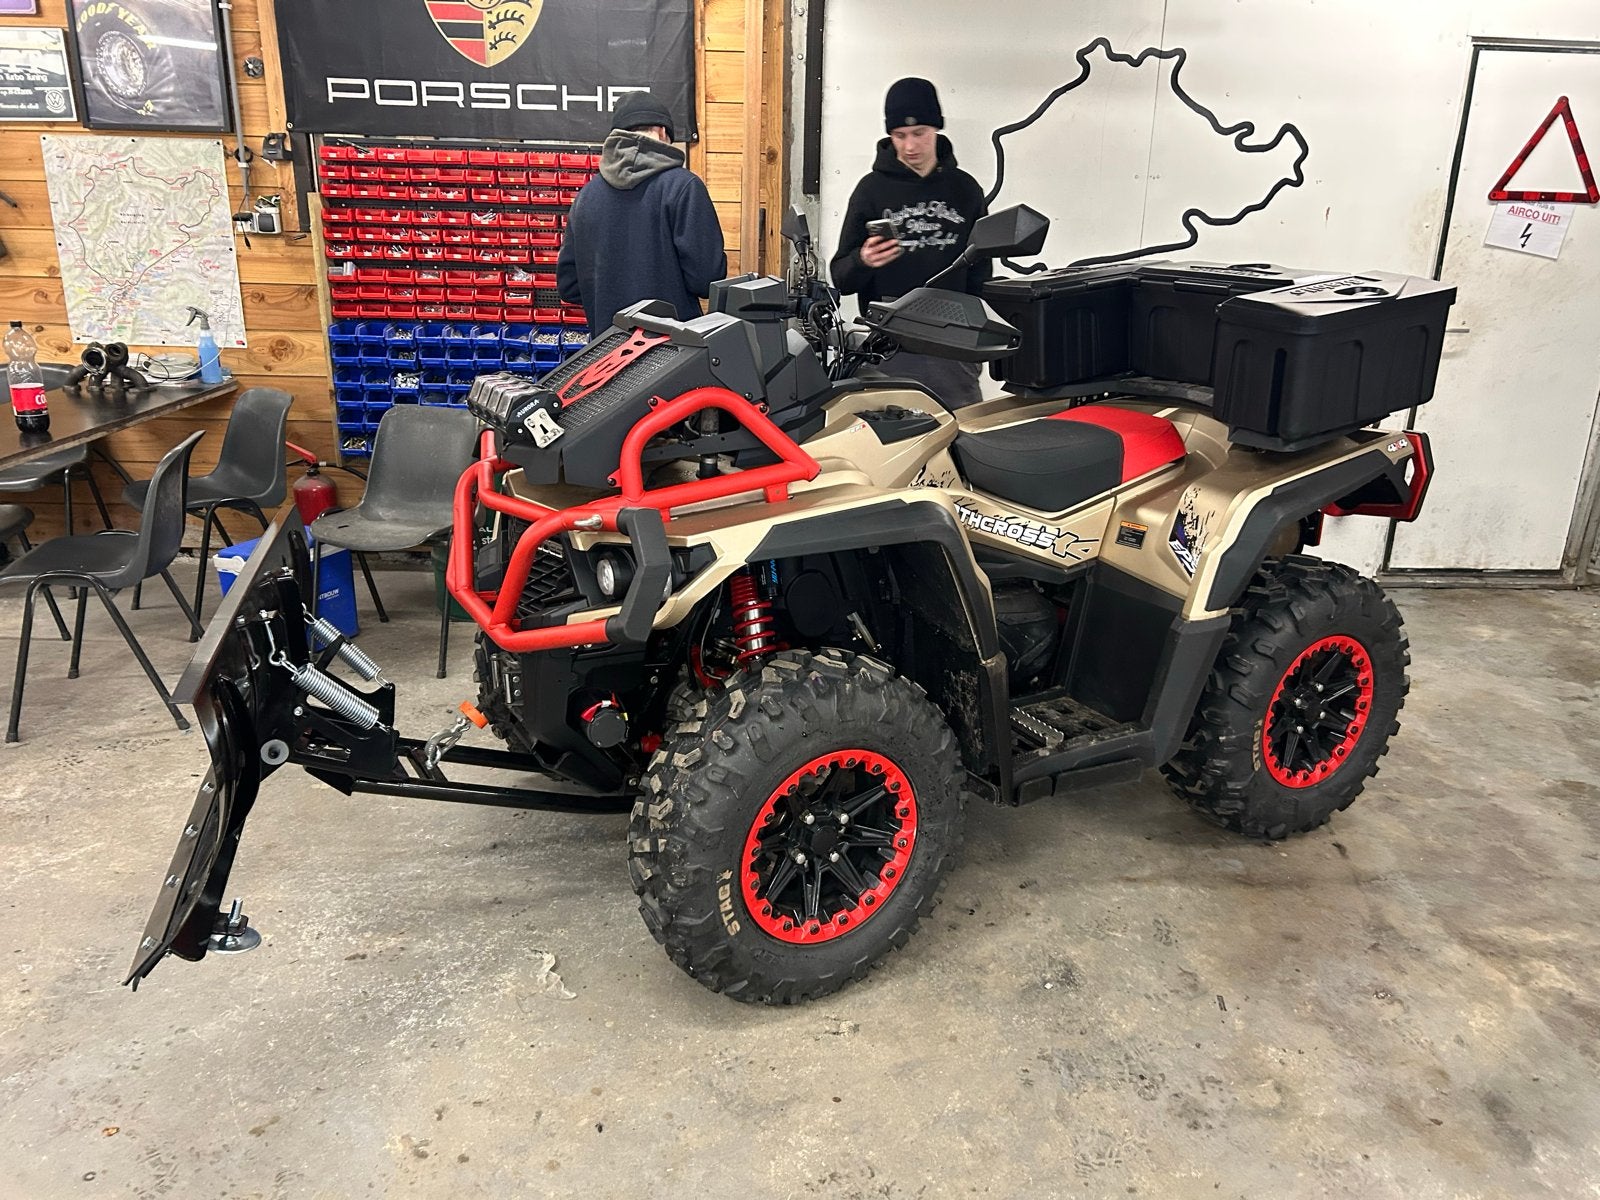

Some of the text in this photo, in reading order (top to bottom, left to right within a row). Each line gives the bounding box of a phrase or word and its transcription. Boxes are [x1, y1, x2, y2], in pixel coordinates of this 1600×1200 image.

[1507, 205, 1561, 225] AIRCO UIT!
[516, 398, 540, 419] AURORA
[716, 886, 741, 936] STAG
